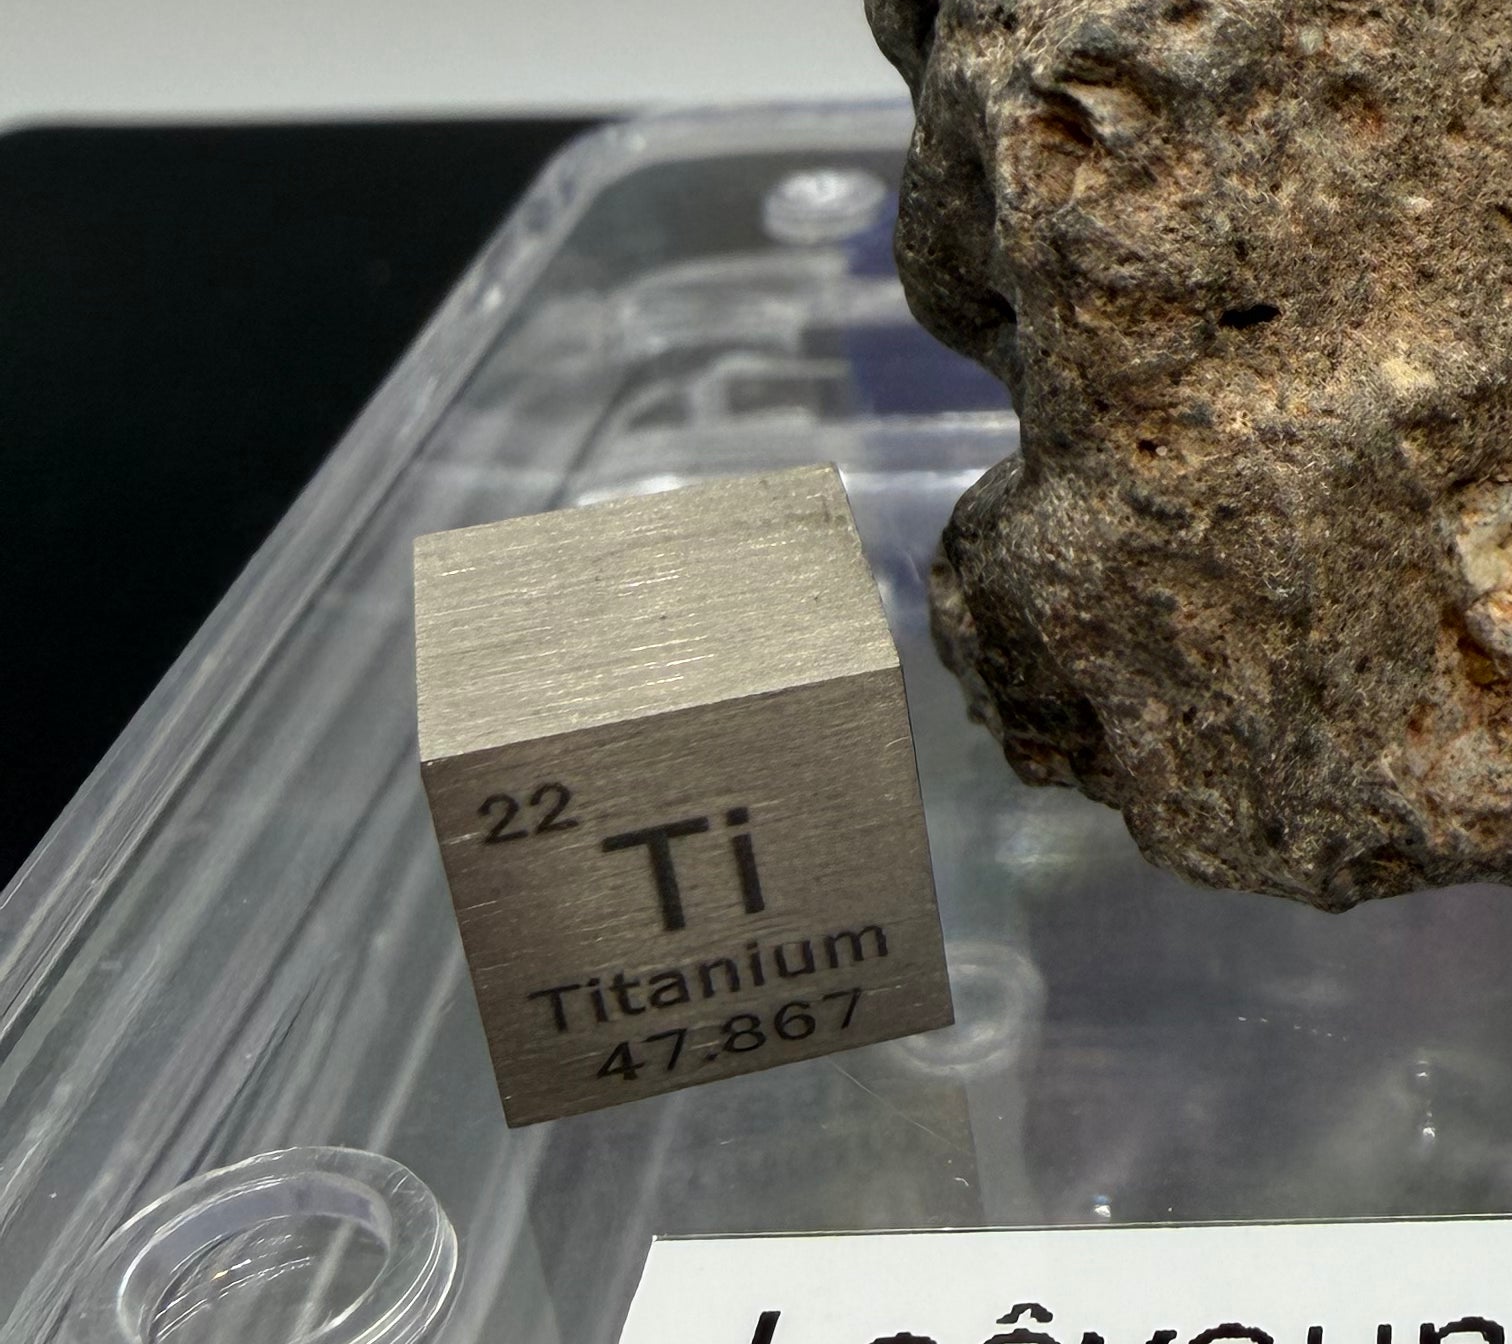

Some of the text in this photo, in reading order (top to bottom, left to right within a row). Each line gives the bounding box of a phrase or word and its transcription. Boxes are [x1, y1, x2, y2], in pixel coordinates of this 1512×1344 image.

[475, 781, 581, 850] 22
[599, 806, 766, 933] Ti
[526, 923, 890, 1034] Titanium
[597, 987, 865, 1083] 47.867
